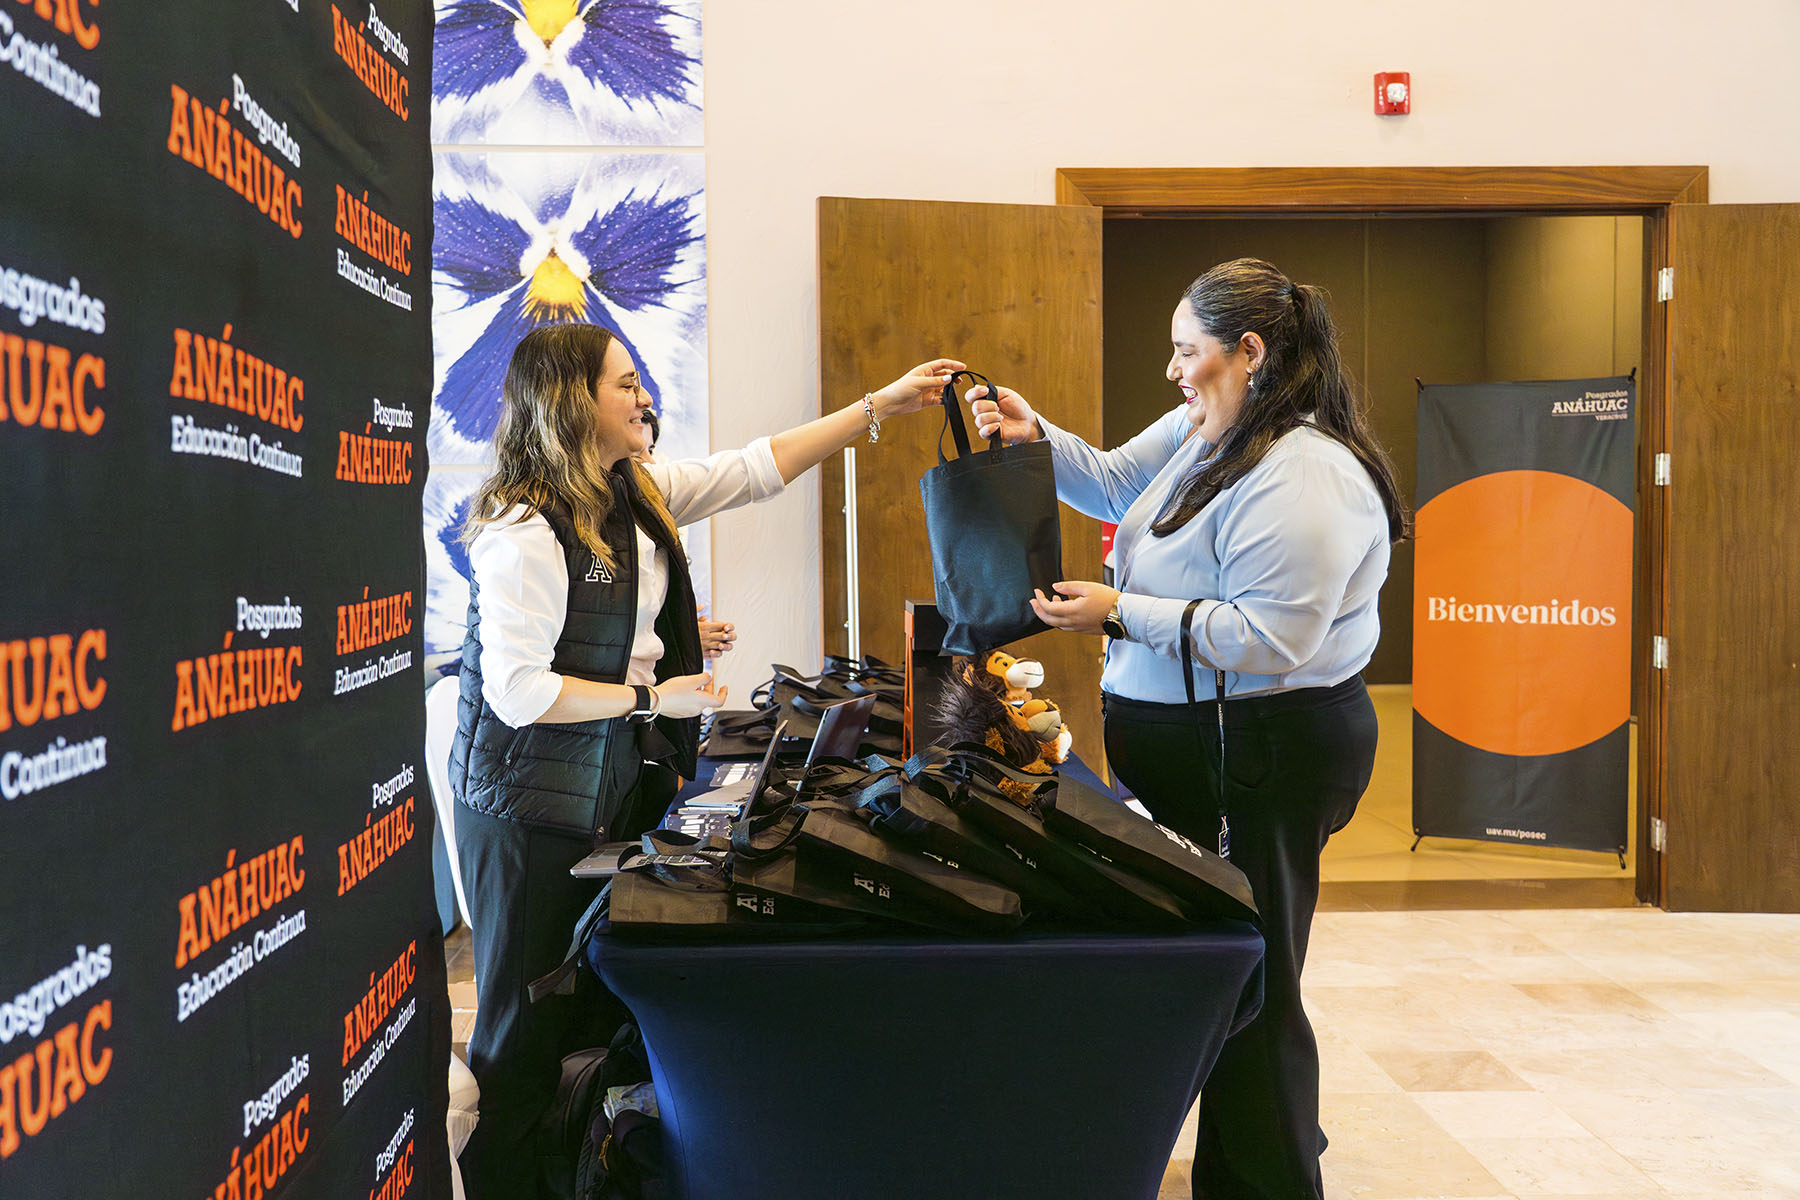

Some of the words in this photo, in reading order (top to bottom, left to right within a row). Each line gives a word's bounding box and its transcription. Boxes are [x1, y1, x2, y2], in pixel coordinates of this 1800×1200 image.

[331, 3, 408, 121] ANÁHUAC
[368, 3, 408, 66] Posgrados
[232, 73, 301, 168] Posgrados
[168, 84, 302, 239] ANÁHUAC
[335, 184, 411, 276] ANÁHUAC
[0, 265, 105, 334] sgrados
[337, 248, 380, 297] Educación
[380, 276, 411, 311] Continua
[170, 323, 304, 433] ANÁHUAC
[1551, 397, 1628, 414] ANÁHUAC
[171, 414, 248, 462] Educación
[249, 433, 302, 477] Continua
[373, 398, 413, 433] Posgrados
[336, 422, 412, 484] ANÁHUAC
[236, 596, 302, 639] Posgrados
[336, 586, 412, 655] ANÁHUAC
[1428, 596, 1617, 627] Bienvenidos
[172, 631, 302, 732] ANÁHUAC
[333, 659, 378, 695] Educación
[379, 649, 412, 679] Continua
[0, 736, 107, 800] Continua
[372, 764, 414, 808] Posgrados
[338, 796, 414, 896] ANÁHUAC
[1485, 827, 1547, 840] uav.mx/posec
[175, 834, 305, 969] ANÁHUAC
[177, 942, 253, 1022] Educación
[254, 909, 306, 962] Continua
[342, 940, 416, 1067] ANÁHUAC
[343, 1039, 385, 1106] Educación
[385, 998, 416, 1050] Continua
[243, 1053, 309, 1138] Posgrados
[376, 1108, 414, 1182] Posgrados
